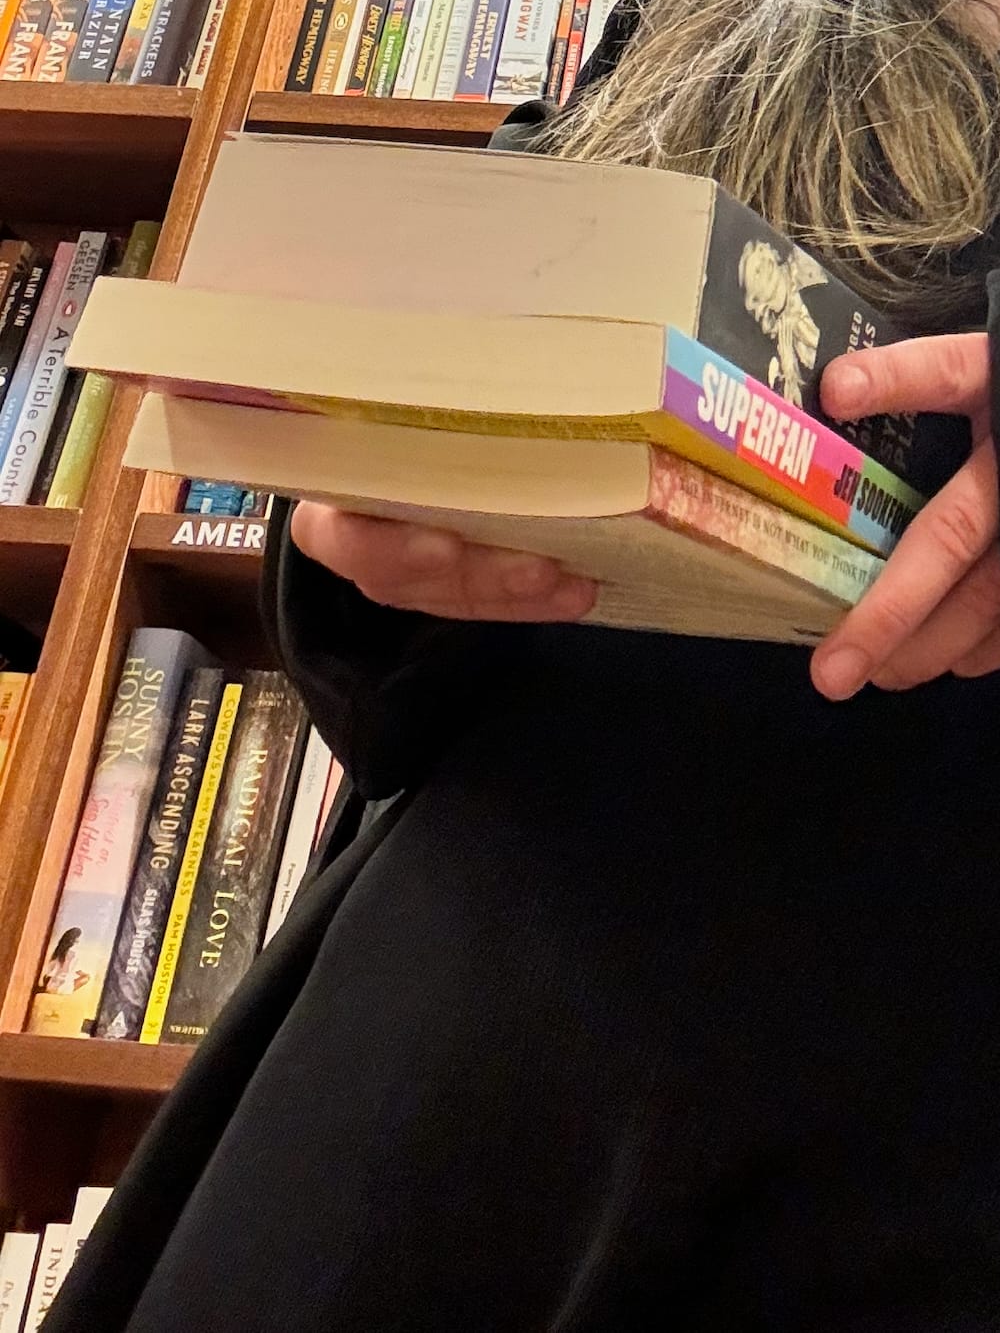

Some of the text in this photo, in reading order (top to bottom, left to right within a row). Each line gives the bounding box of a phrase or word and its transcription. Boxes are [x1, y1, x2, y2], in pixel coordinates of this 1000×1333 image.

[141, 9, 171, 78] TRACKERS
[295, 8, 325, 84] HEMINGWAY
[353, 4, 384, 81] ERNEST HEMINGWAY
[481, 12, 499, 60] ERNEST
[66, 239, 90, 291] GESSEN
[80, 248, 100, 285] KEITH
[27, 326, 69, 420] A Terrible
[698, 362, 817, 484] SUPERFAN
[833, 463, 861, 507] JEN
[171, 521, 266, 549] AMER
[98, 656, 146, 771] HOSTIN
[125, 668, 165, 764] SUNNY
[124, 699, 210, 975] LARK ASCENDING SILAS HOUSE
[153, 698, 236, 1005] COWBOYS WEAKNESS PAM HOUSTON
[198, 748, 269, 970] RADICAL LOVE
